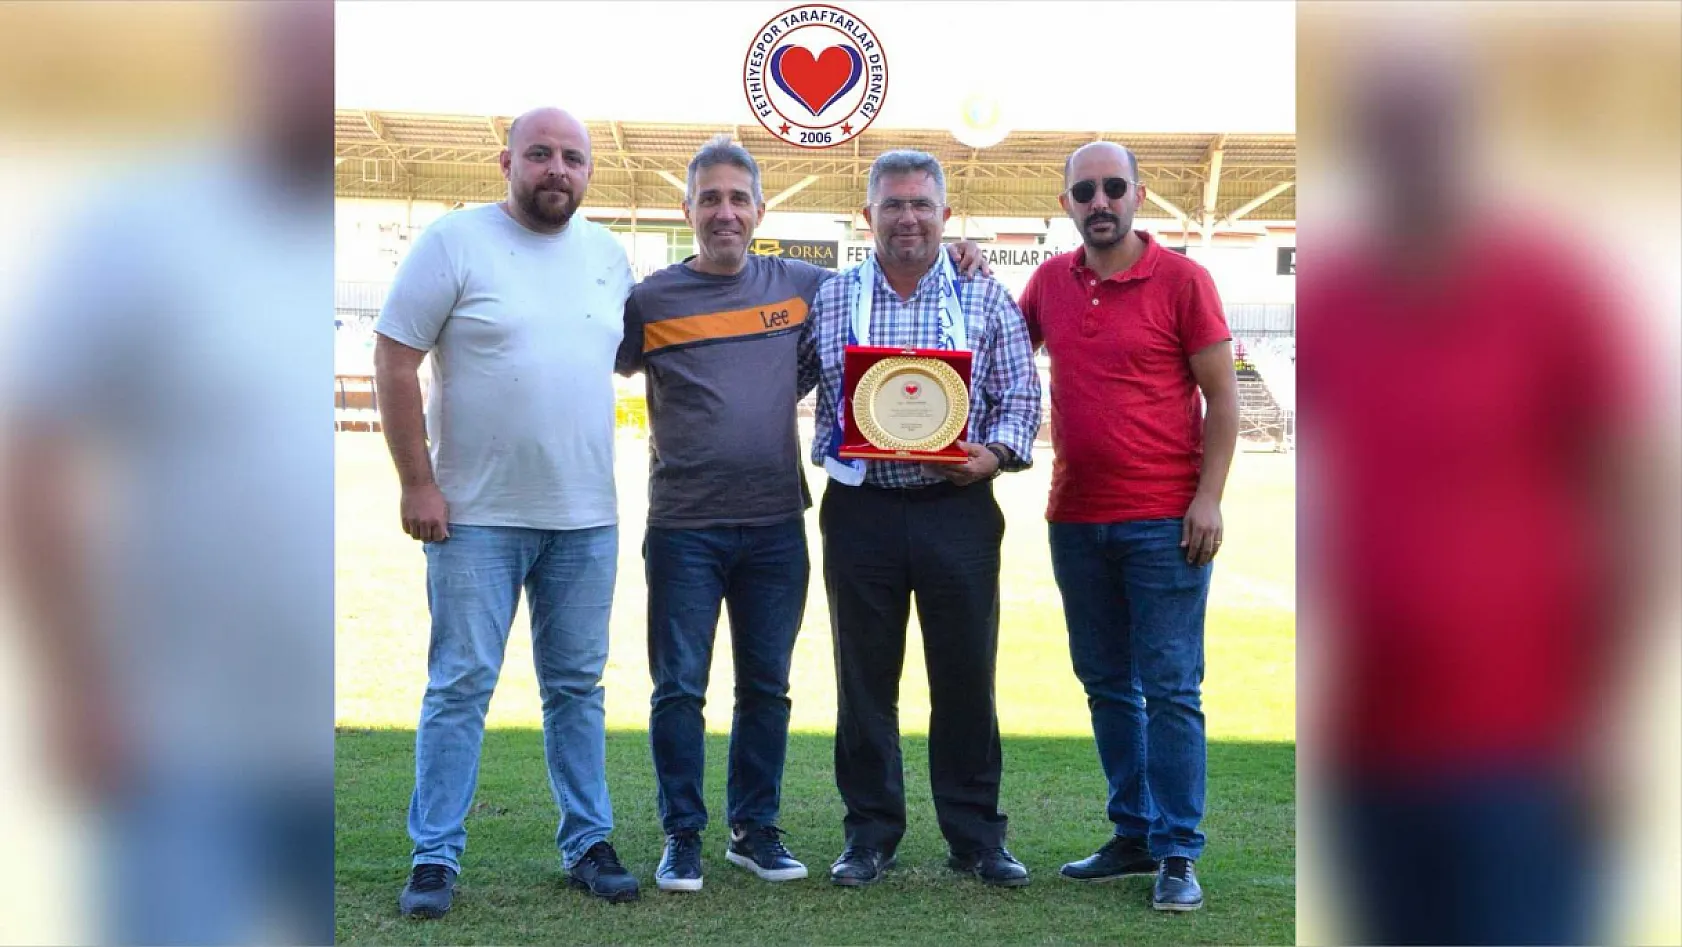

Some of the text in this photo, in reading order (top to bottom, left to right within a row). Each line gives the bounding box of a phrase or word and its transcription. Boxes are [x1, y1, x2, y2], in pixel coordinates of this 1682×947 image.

[789, 245, 834, 259] ORKA
[847, 246, 871, 262] FET
[981, 249, 1039, 266] SARILAR
[760, 309, 789, 328] Lee
